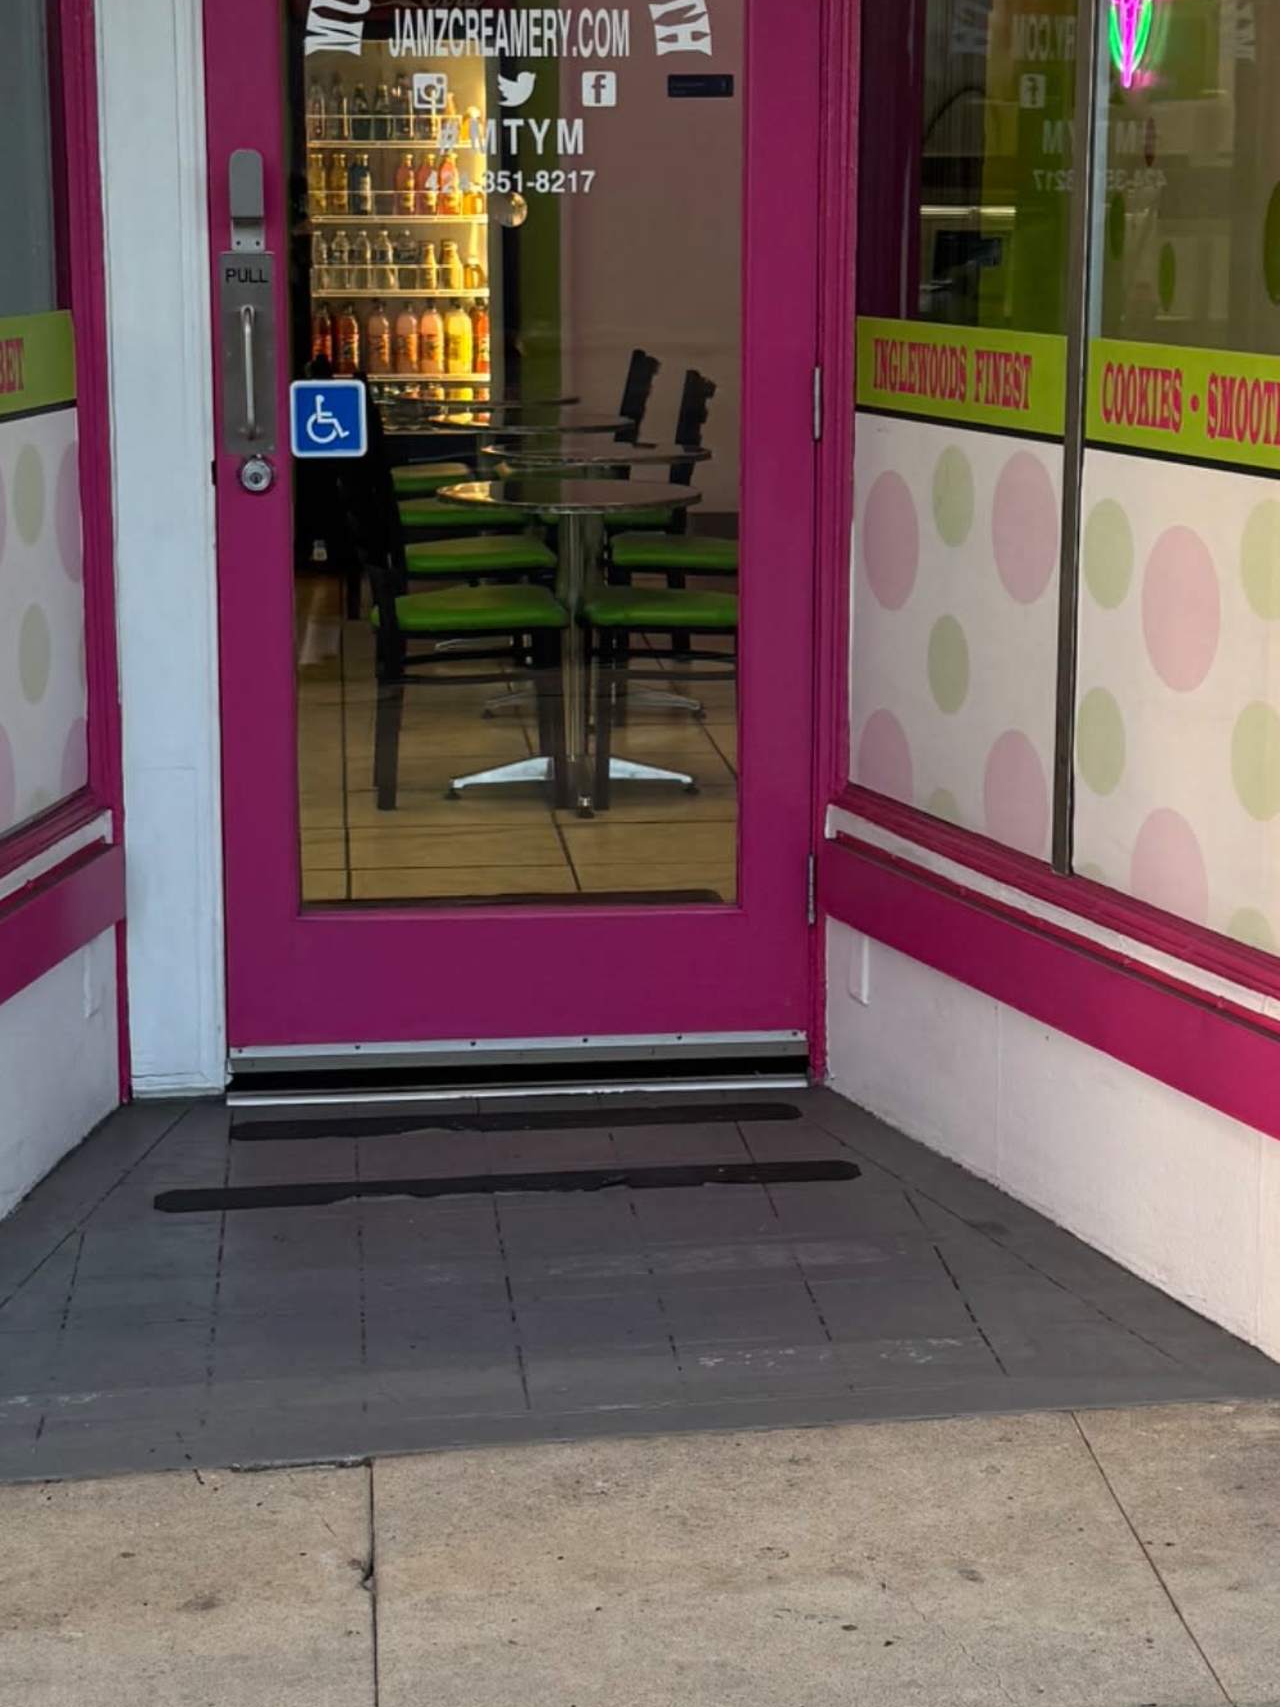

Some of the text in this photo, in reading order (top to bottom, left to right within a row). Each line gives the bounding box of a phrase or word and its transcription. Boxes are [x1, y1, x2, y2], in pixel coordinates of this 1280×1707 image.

[389, 8, 629, 57] JAMZCREAMERY.COM
[225, 267, 269, 284] PULL
[873, 338, 1033, 411] INGLEWOODS FINEST
[1102, 362, 1182, 434] COOKIES
